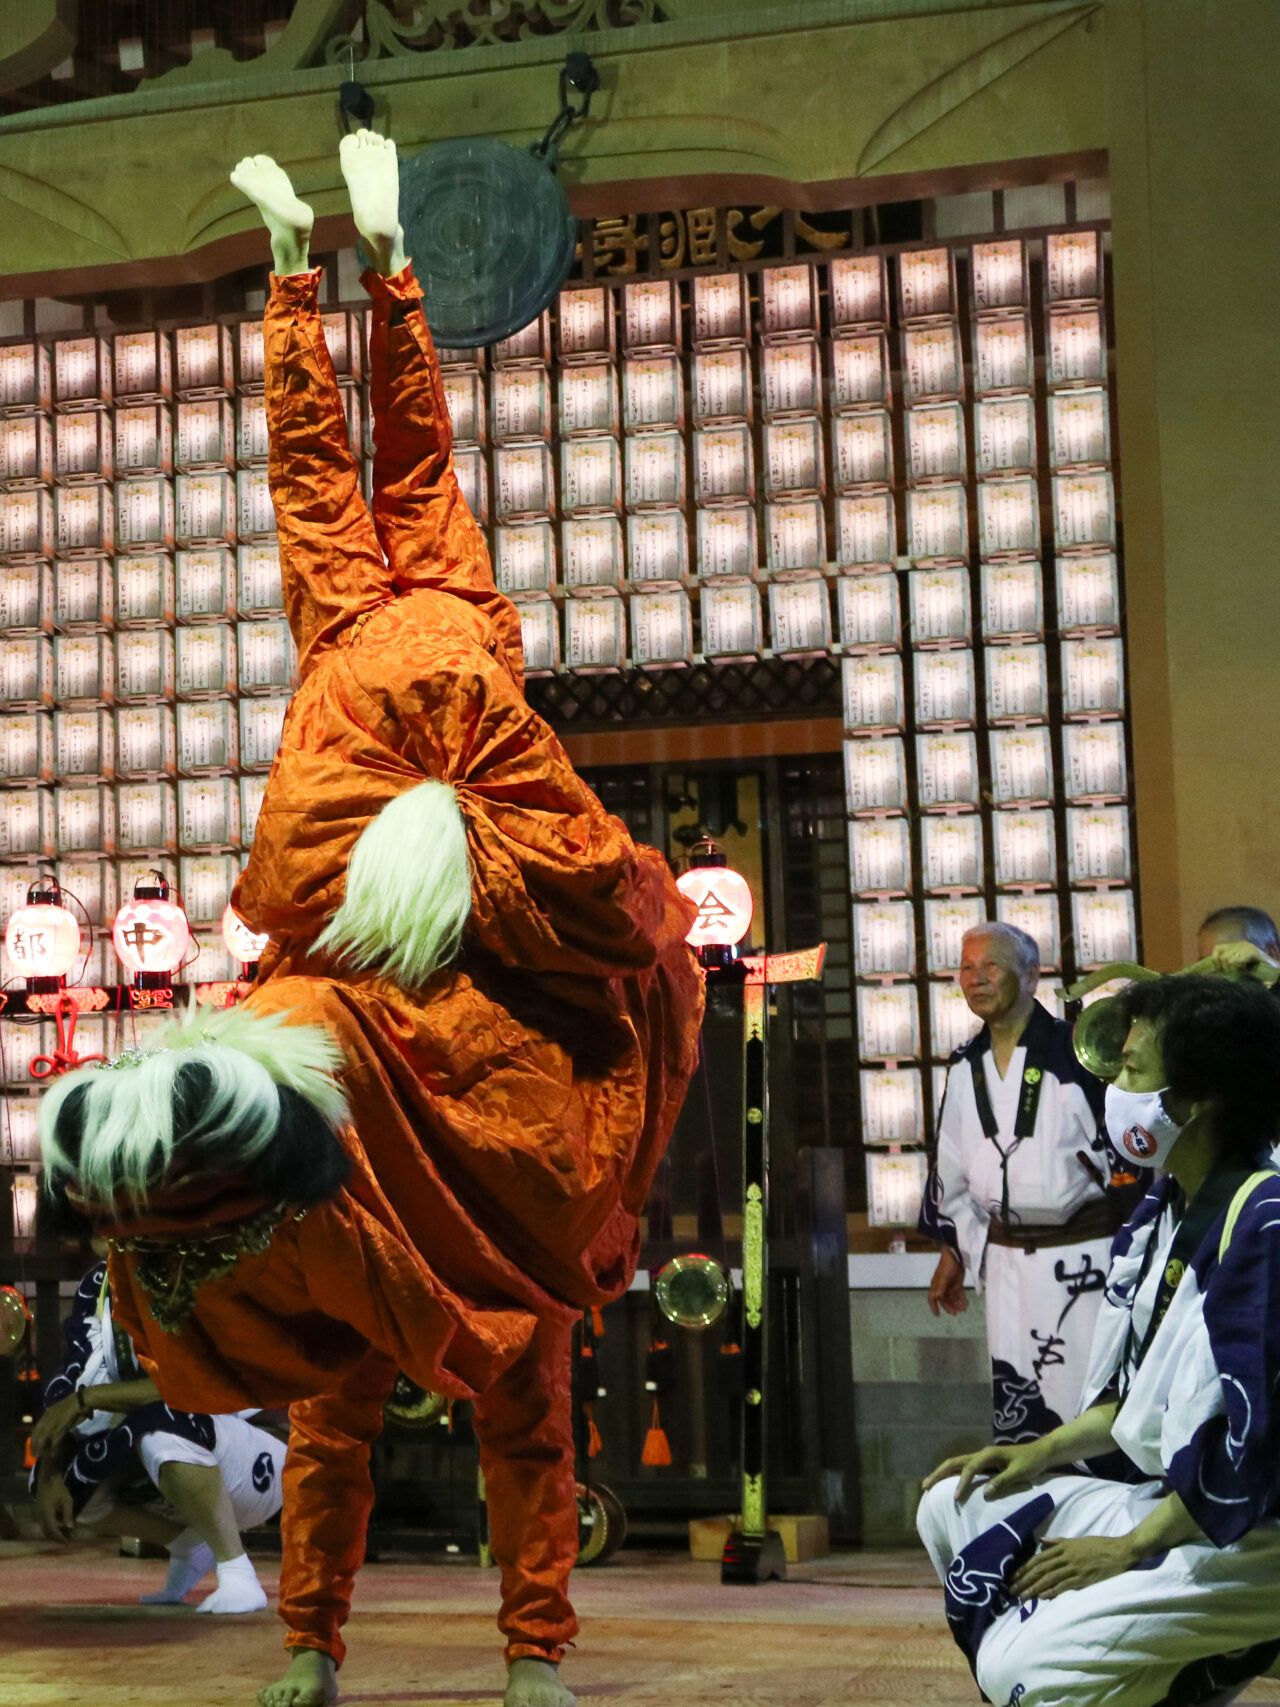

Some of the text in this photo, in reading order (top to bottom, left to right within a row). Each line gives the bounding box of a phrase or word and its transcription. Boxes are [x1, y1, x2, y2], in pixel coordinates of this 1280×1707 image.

[13, 928, 47, 962] 都
[121, 922, 164, 965] 中
[697, 889, 736, 929] 会
